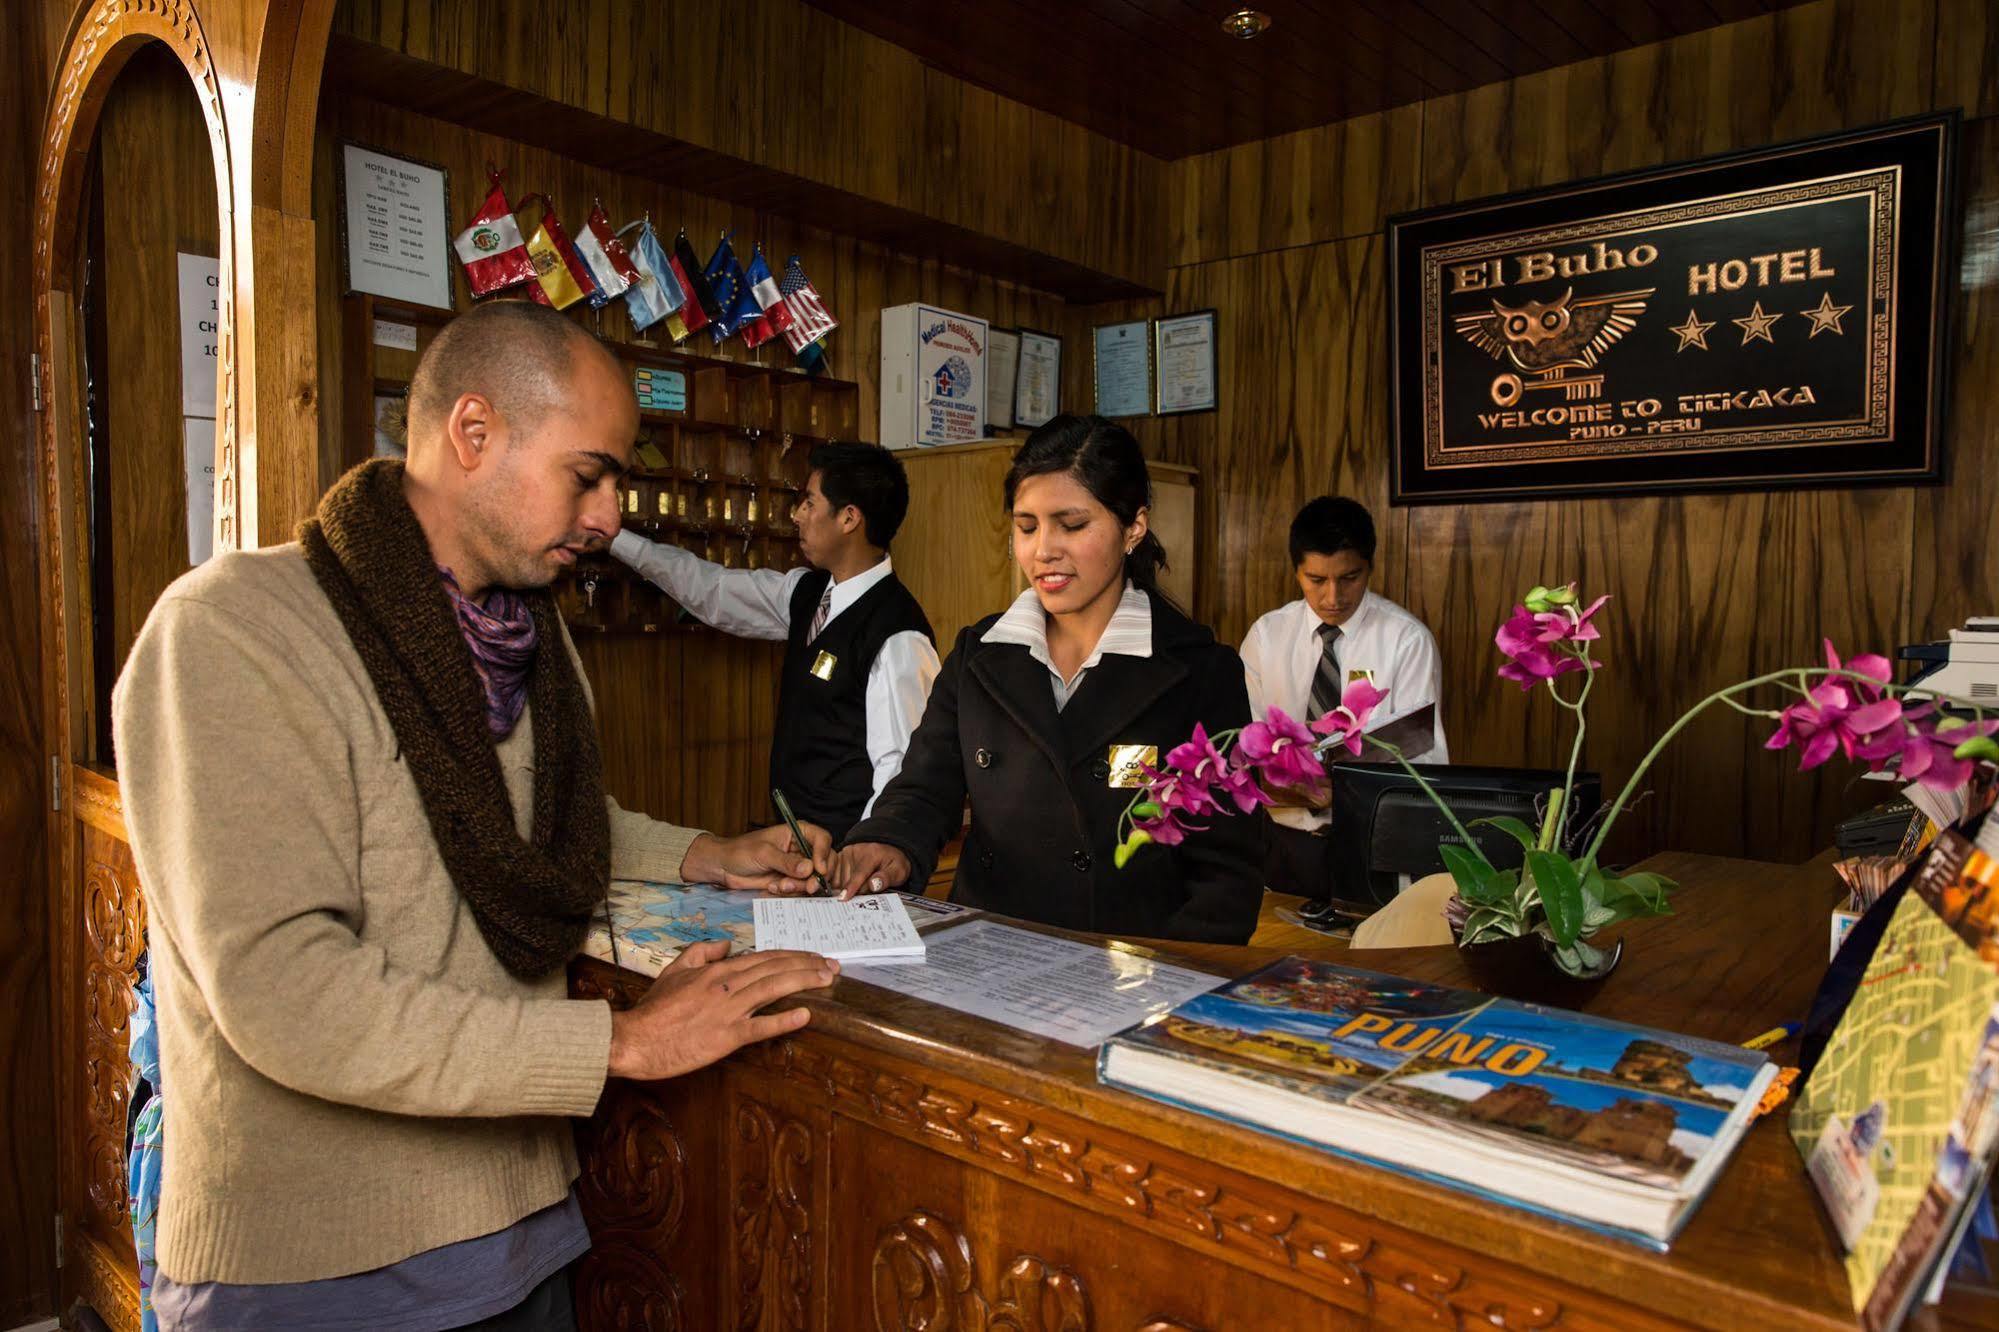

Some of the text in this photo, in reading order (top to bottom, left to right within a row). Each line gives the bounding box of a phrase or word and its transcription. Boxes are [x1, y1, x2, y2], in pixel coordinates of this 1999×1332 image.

[365, 161, 421, 184] HOTEL EL BUHO
[1450, 241, 1659, 295] El Buho
[1688, 247, 1835, 296] HOTEL
[1478, 402, 1612, 430] WELCOME
[1621, 399, 1662, 418] TO
[1439, 835, 1483, 844] SAMSG
[1331, 1012, 1548, 1077] PUNO
